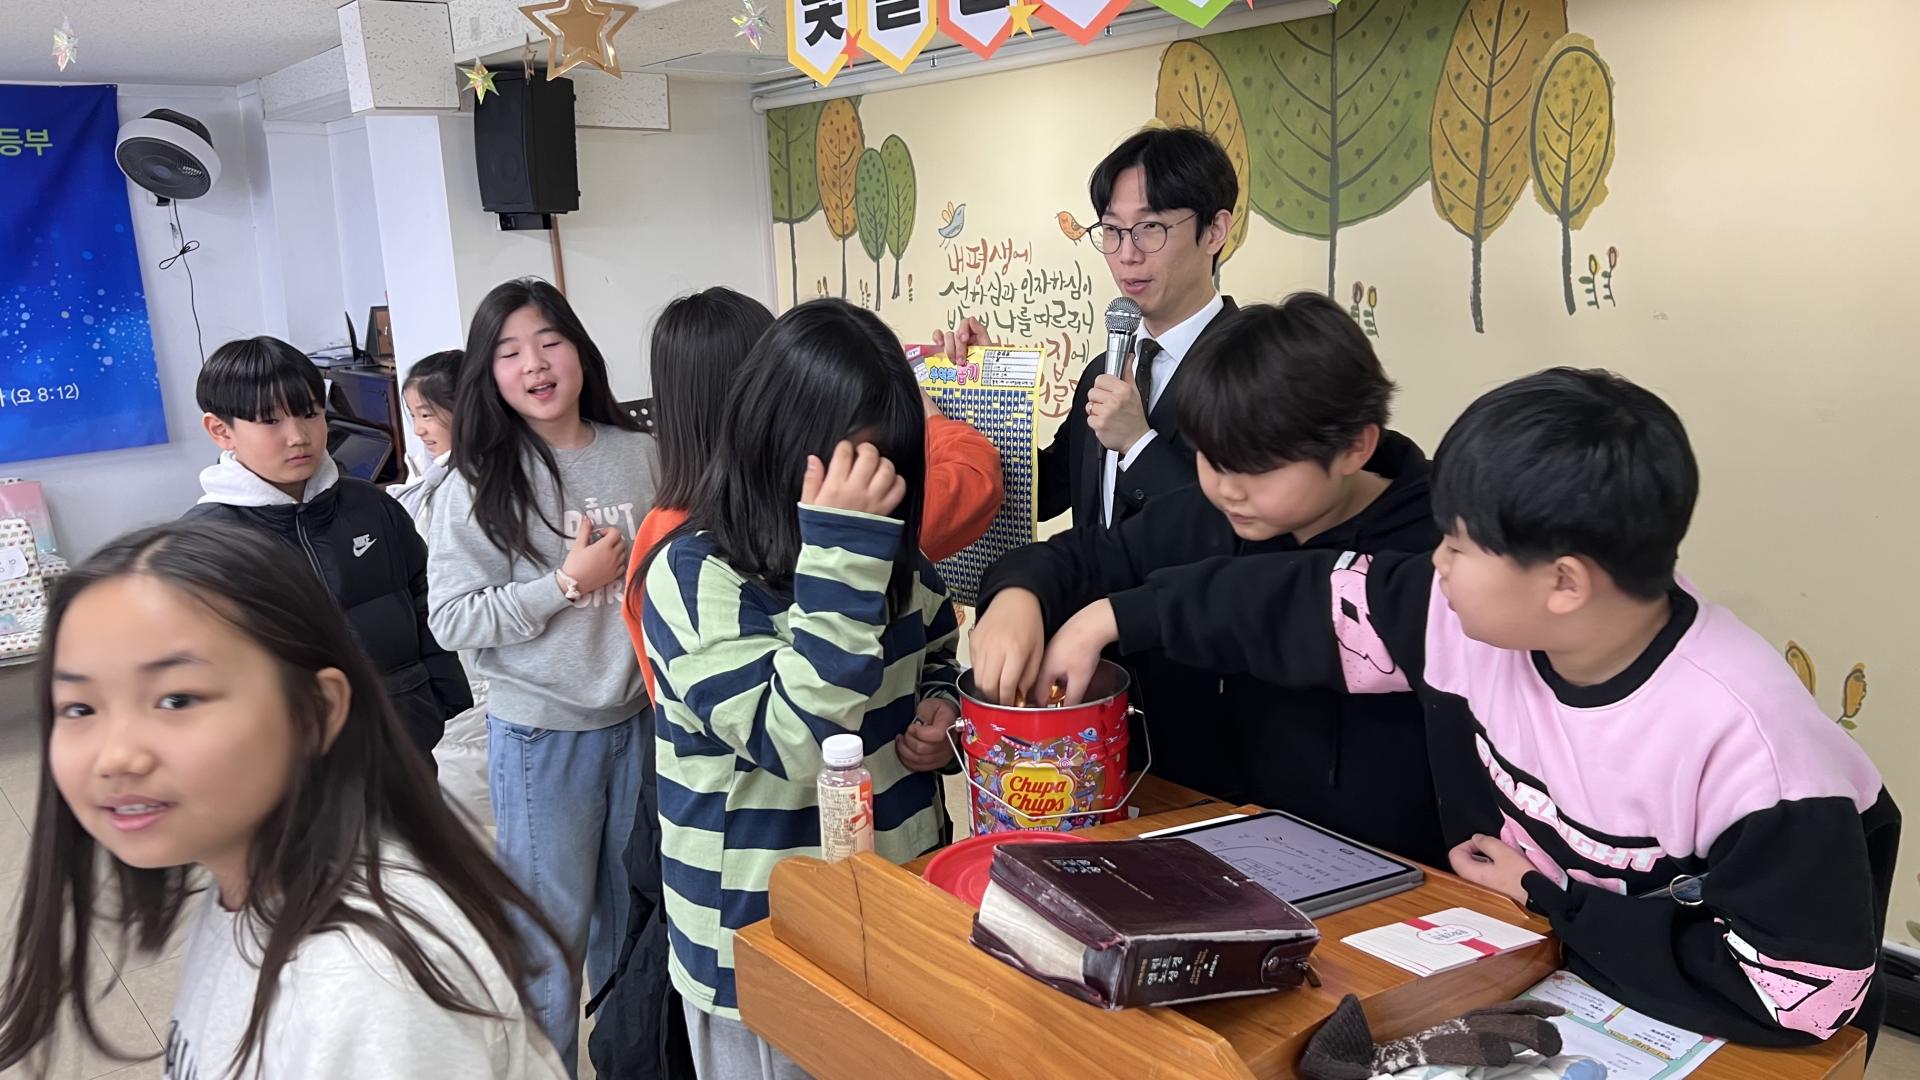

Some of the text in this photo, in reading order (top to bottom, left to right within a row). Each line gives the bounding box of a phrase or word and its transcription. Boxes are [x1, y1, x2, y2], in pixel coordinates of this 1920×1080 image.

[37, 382, 80, 403] 8:12)
[1009, 775, 1067, 798] Chupa
[1007, 792, 1065, 815] Chups
